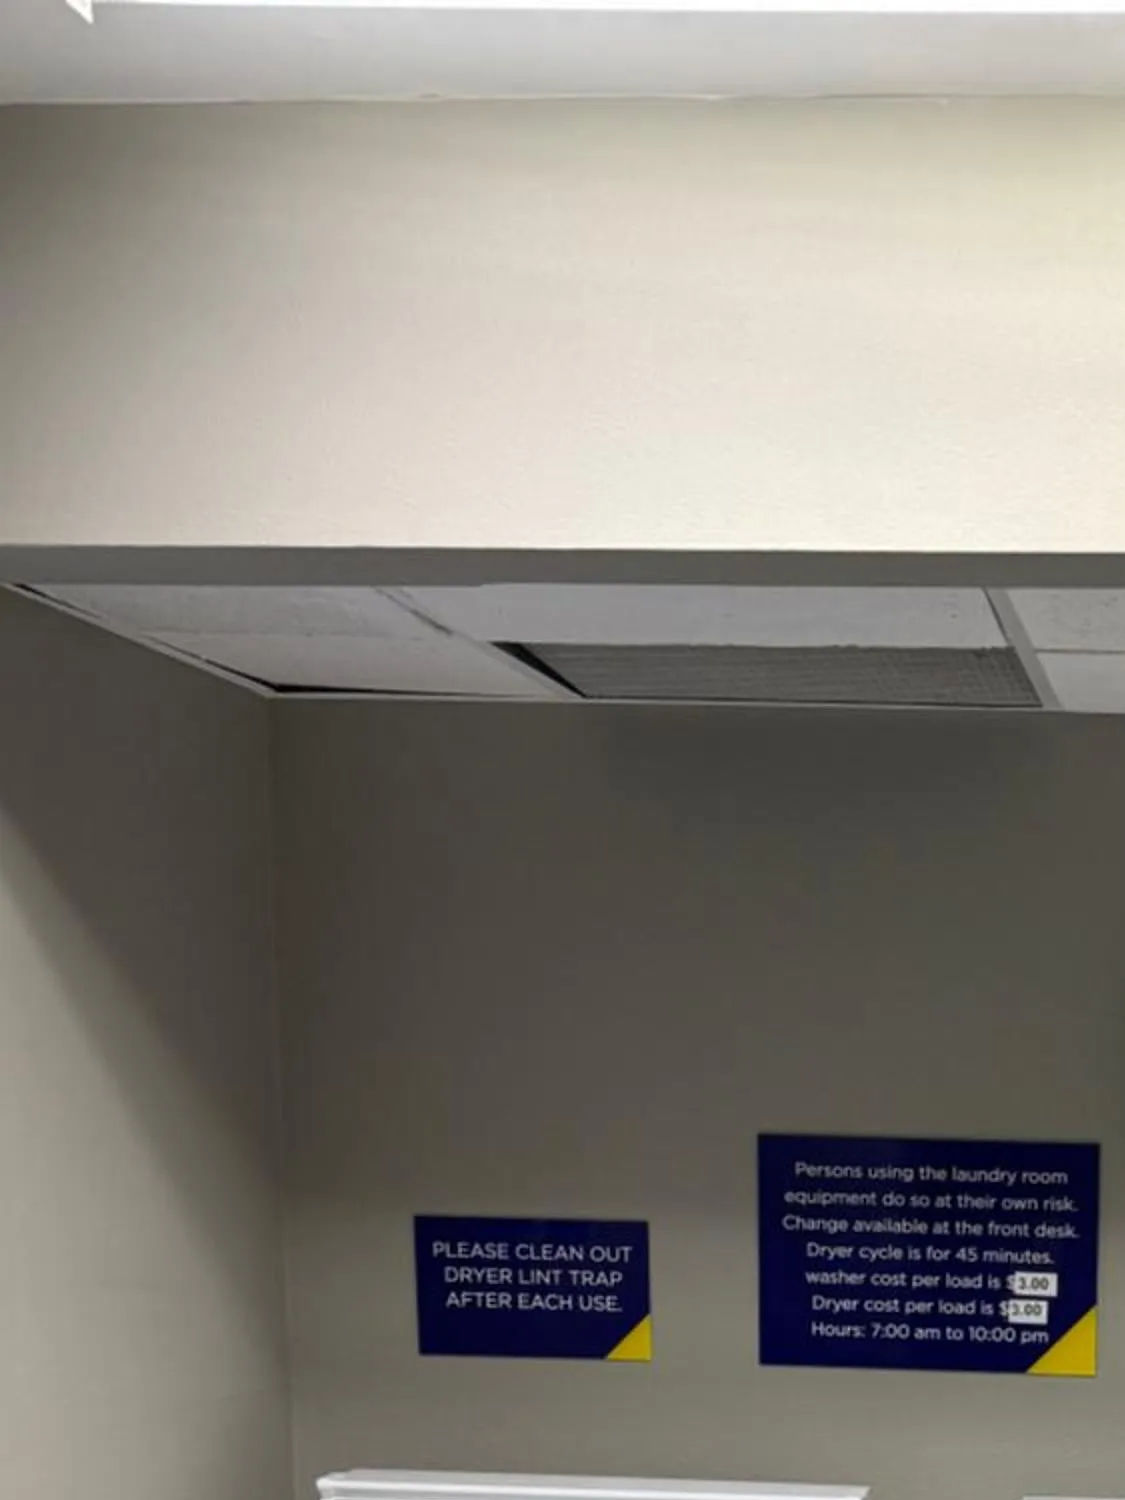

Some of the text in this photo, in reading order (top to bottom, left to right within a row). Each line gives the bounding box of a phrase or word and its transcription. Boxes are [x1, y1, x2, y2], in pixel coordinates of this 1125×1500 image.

[795, 1162, 1068, 1186] Persons using the laundry room
[784, 1191, 1079, 1212] equipment do so at their own risk.
[782, 1216, 1079, 1238] Change available at the front desk.
[432, 1241, 632, 1263] PLEASE CLEAN OUT
[807, 1242, 1054, 1264] Dryer cycle is for 45 minutes.
[444, 1266, 623, 1287] DRYER LINT TRAP
[805, 1269, 865, 1285] washer
[871, 1272, 906, 1286] cost
[912, 1275, 939, 1291] per
[946, 1273, 982, 1289] load
[988, 1275, 1000, 1288] is
[446, 1292, 622, 1312] AFTER EACH USE.
[812, 1295, 859, 1313] Dryer
[864, 1299, 899, 1313] cost
[905, 1300, 933, 1316] per
[939, 1299, 975, 1315] load
[981, 1302, 993, 1315] is
[812, 1322, 1048, 1345] Hours: 7:00 am to 10:00 pm
